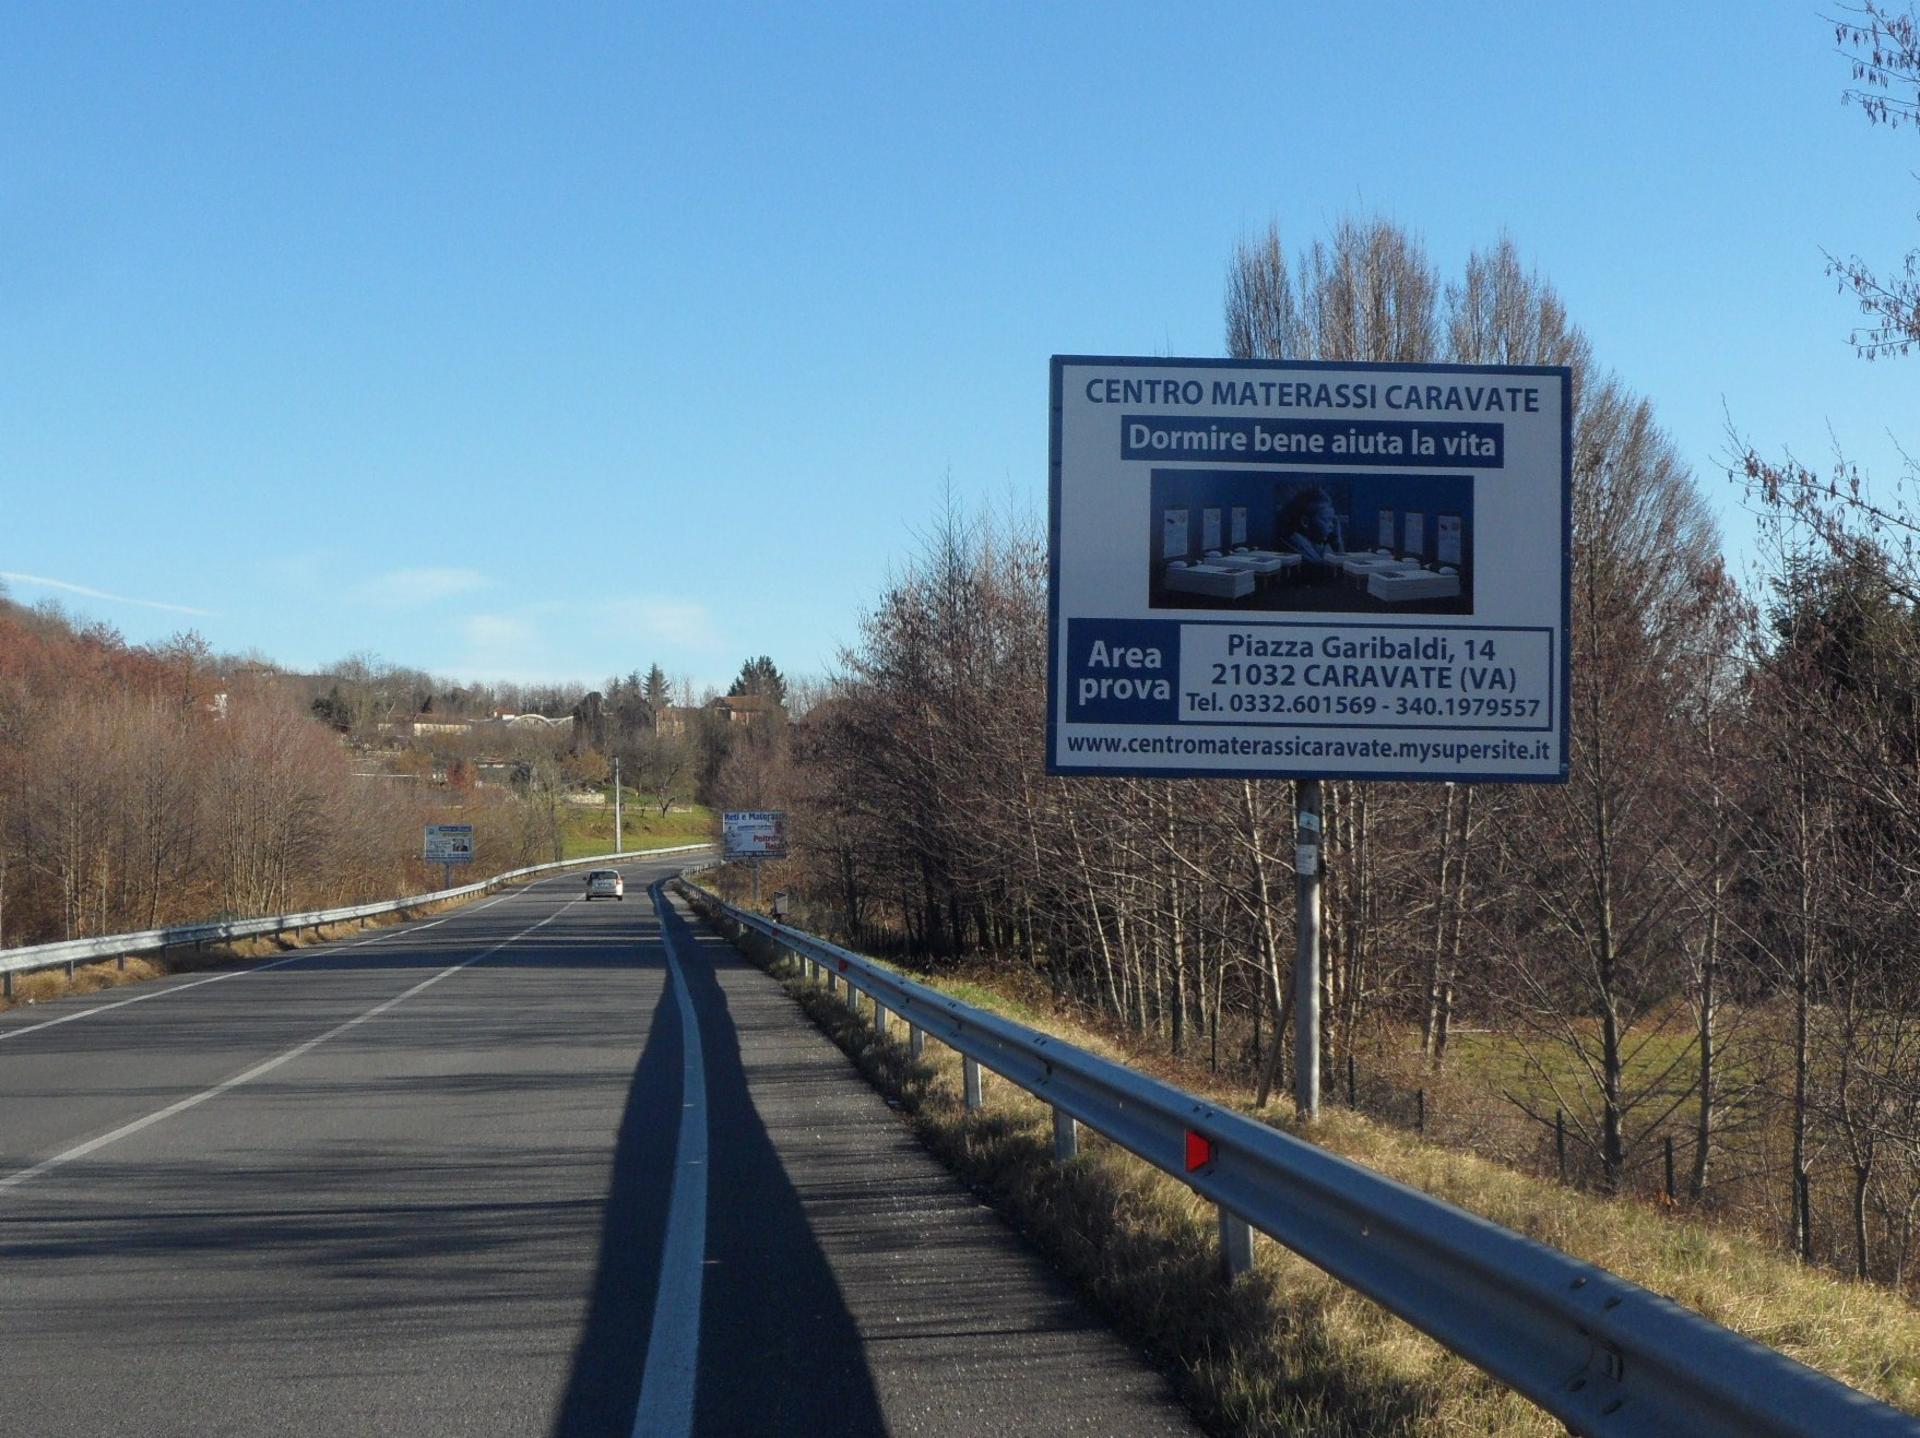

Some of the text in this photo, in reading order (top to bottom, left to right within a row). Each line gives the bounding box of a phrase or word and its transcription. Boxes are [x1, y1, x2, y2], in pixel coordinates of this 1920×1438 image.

[1085, 378, 1540, 413] CENTRO MATERASSI CARAVATE
[1129, 424, 1496, 457] Dormire bene aiuta la vita
[1088, 640, 1162, 669] Area
[1228, 633, 1496, 664] Piazza Garibaldi, 14
[1078, 677, 1171, 706] prova
[1211, 663, 1517, 694] 21032 CARAVATE (VA)
[1185, 692, 1224, 713] Tel.
[1229, 693, 1377, 715] 0332.601569
[1395, 697, 1540, 718] 340.1979557
[1067, 735, 1550, 764] www.centromaterassicaravate.mysupersite.it
